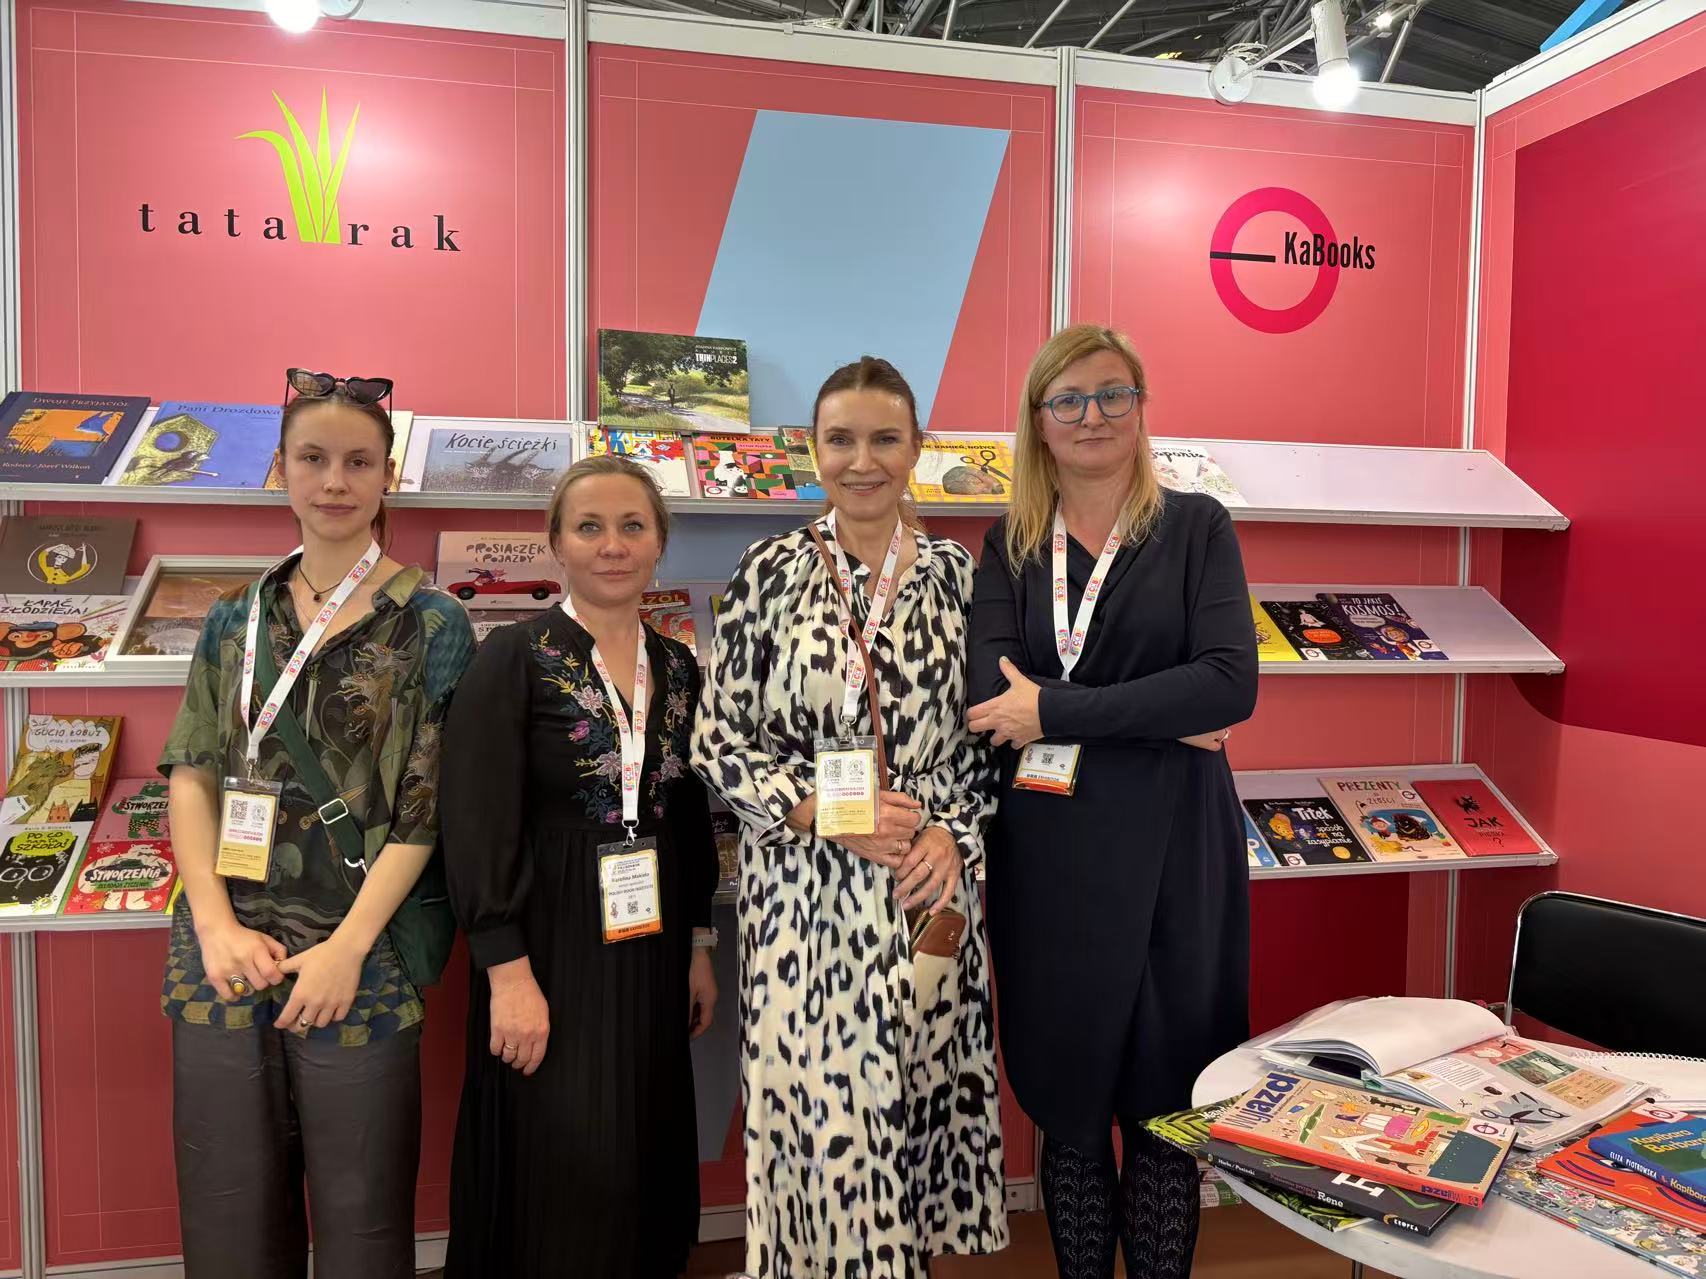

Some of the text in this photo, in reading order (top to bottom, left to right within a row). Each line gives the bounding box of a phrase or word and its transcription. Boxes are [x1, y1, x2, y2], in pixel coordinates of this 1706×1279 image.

[1284, 231, 1376, 270] KaBooks
[177, 404, 281, 415] Pani Drozdowa
[445, 432, 495, 449] Kocie
[483, 553, 535, 563] POJAZDY
[24, 598, 73, 608] ŁAPAĆ
[1351, 597, 1361, 605] TO
[1341, 603, 1401, 617] KOSMOS!
[1336, 780, 1402, 791] PREZENTY
[1292, 806, 1334, 821] Titek
[1463, 816, 1504, 828] JAK
[27, 832, 43, 840] PO
[1221, 1072, 1301, 1130] Wyjazd
[1627, 1129, 1694, 1145] Kapibara
[1609, 1151, 1657, 1179] ELIZA PIOTROWSKA
